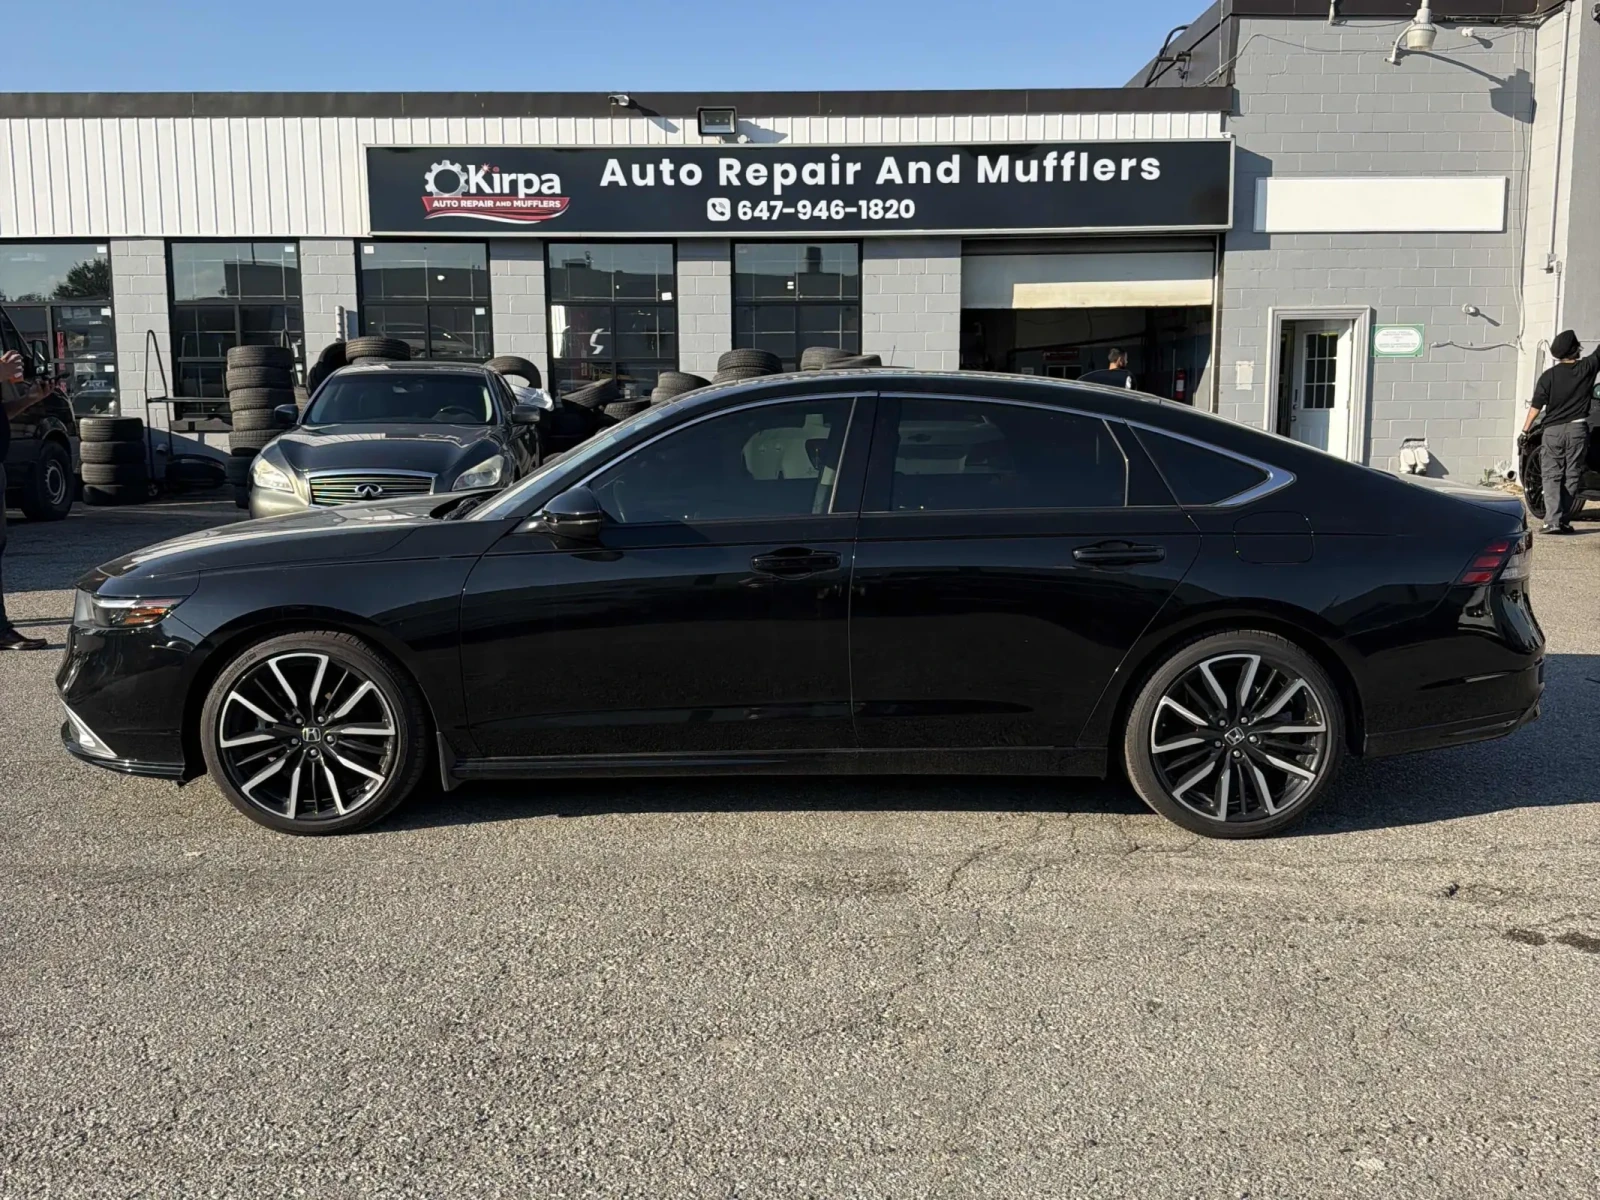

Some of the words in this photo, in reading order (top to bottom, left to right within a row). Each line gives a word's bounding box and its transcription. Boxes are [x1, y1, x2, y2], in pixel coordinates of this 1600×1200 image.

[466, 163, 562, 199] Kirpa
[599, 158, 703, 187] Auto
[718, 154, 862, 196] Repair
[875, 153, 961, 185] And
[977, 151, 1161, 184] Mufflers
[432, 199, 459, 208] AUTO
[460, 199, 494, 208] REPAIR
[495, 200, 512, 208] AND
[512, 199, 561, 208] MUFFLERS
[737, 198, 916, 221] 647-946-1820
